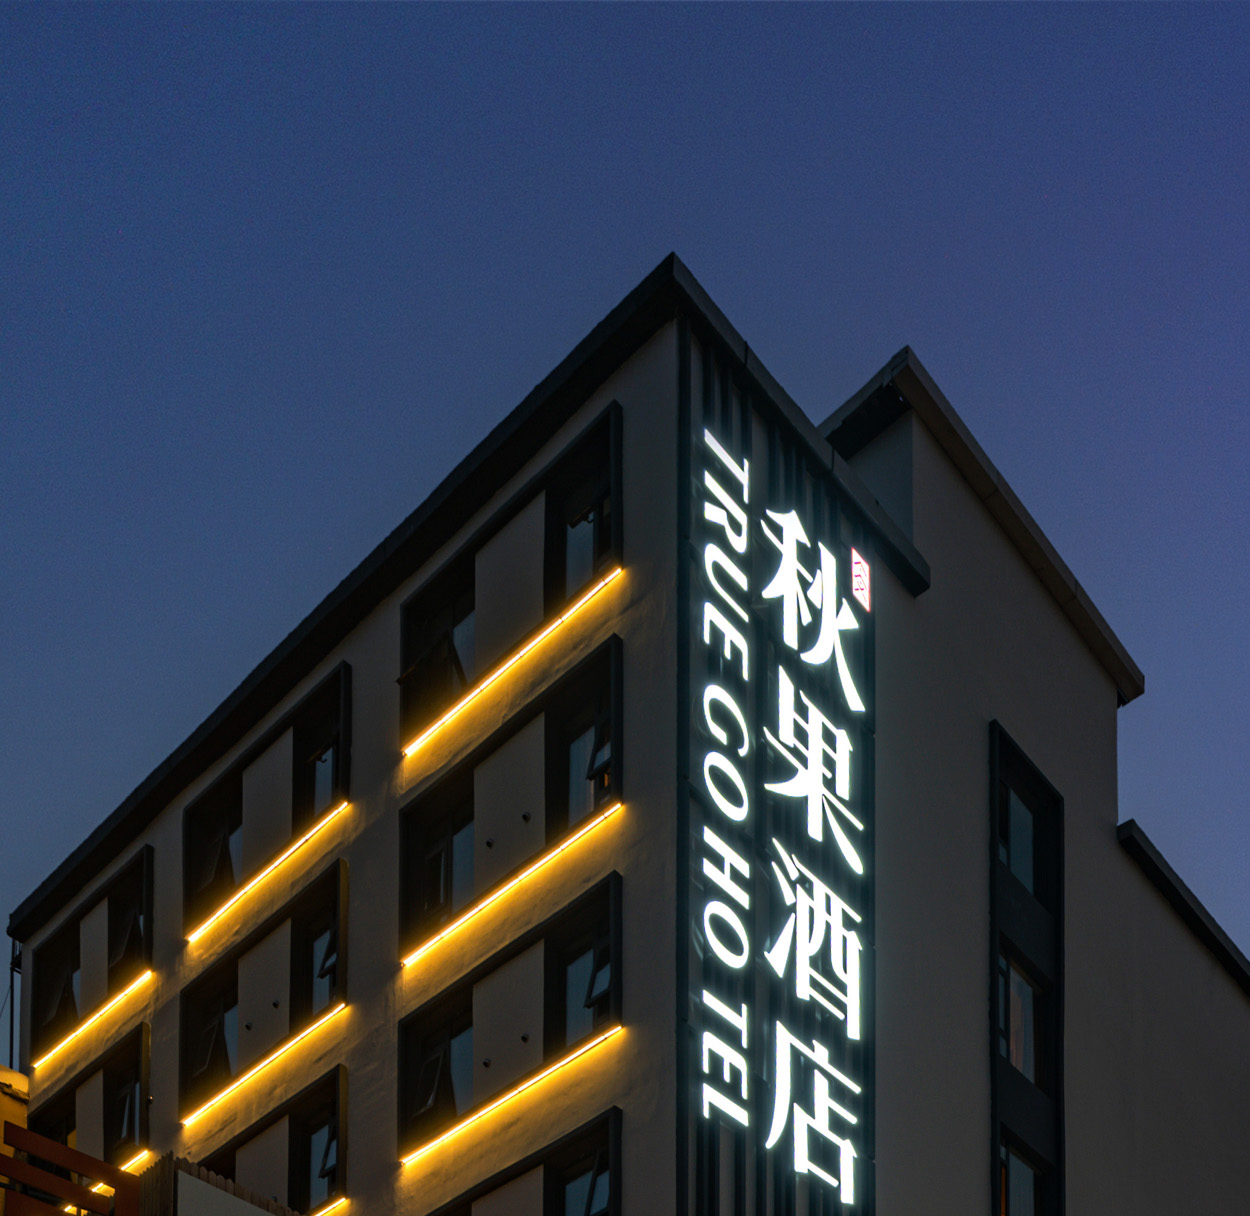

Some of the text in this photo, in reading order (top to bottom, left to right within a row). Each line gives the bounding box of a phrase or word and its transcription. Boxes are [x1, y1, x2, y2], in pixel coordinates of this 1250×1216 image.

[702, 427, 750, 1128] TRUE GO HOTEL
[759, 508, 867, 1206] 秋果酒店
